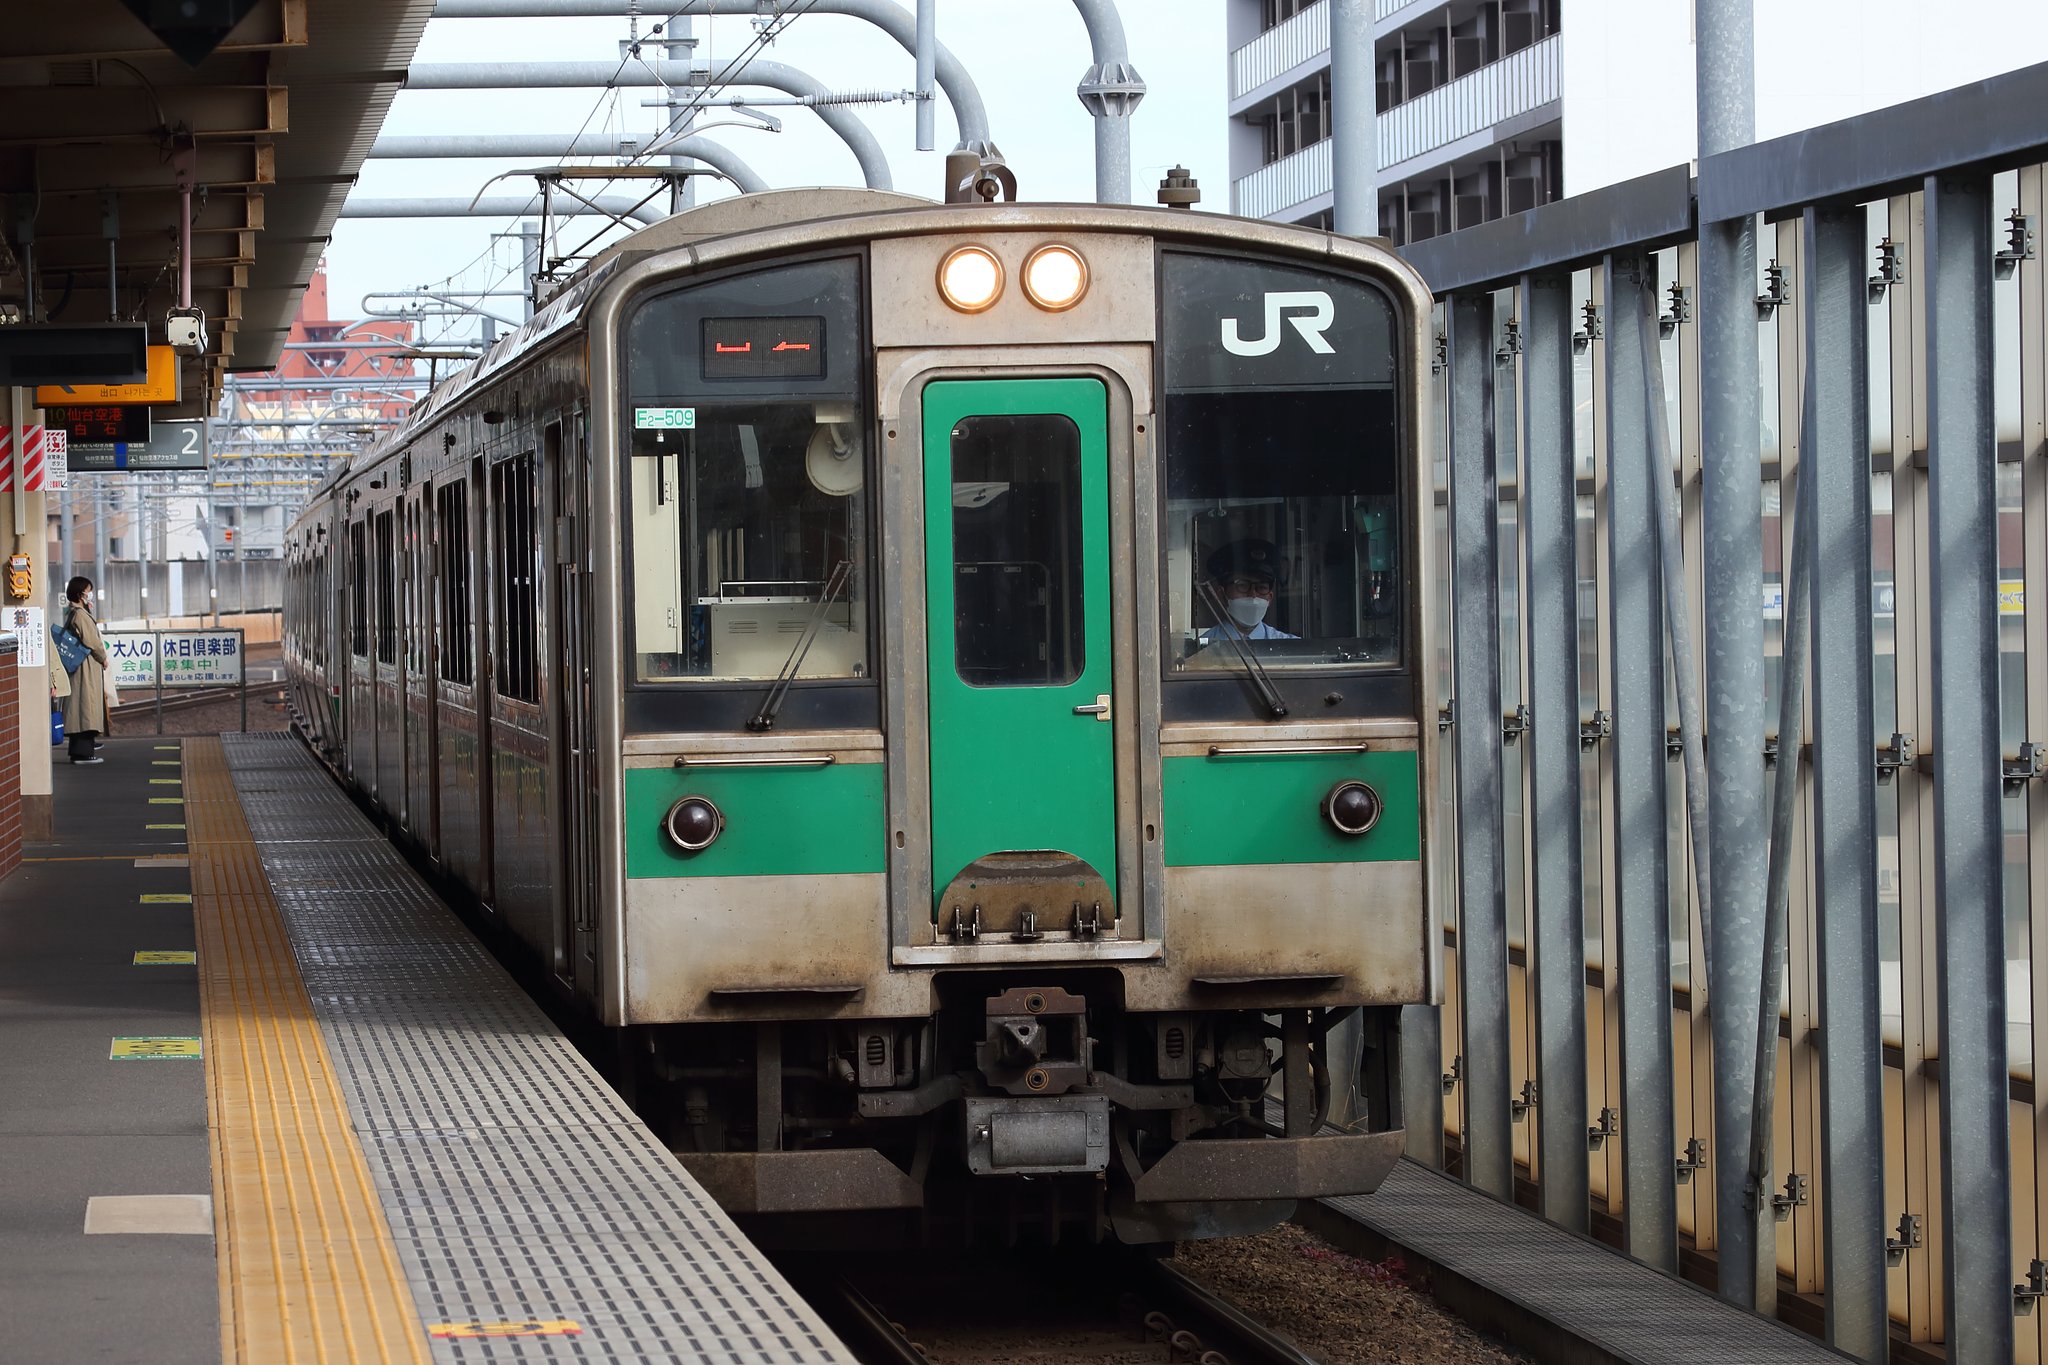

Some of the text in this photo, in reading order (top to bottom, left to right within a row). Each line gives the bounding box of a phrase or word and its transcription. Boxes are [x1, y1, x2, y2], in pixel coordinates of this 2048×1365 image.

[1221, 290, 1337, 357] JR
[100, 388, 118, 397] 出口
[67, 408, 123, 421] 仙台空港
[181, 428, 199, 455] 2
[113, 638, 236, 657] 大人の 休日倶楽部
[122, 660, 153, 671] 会員
